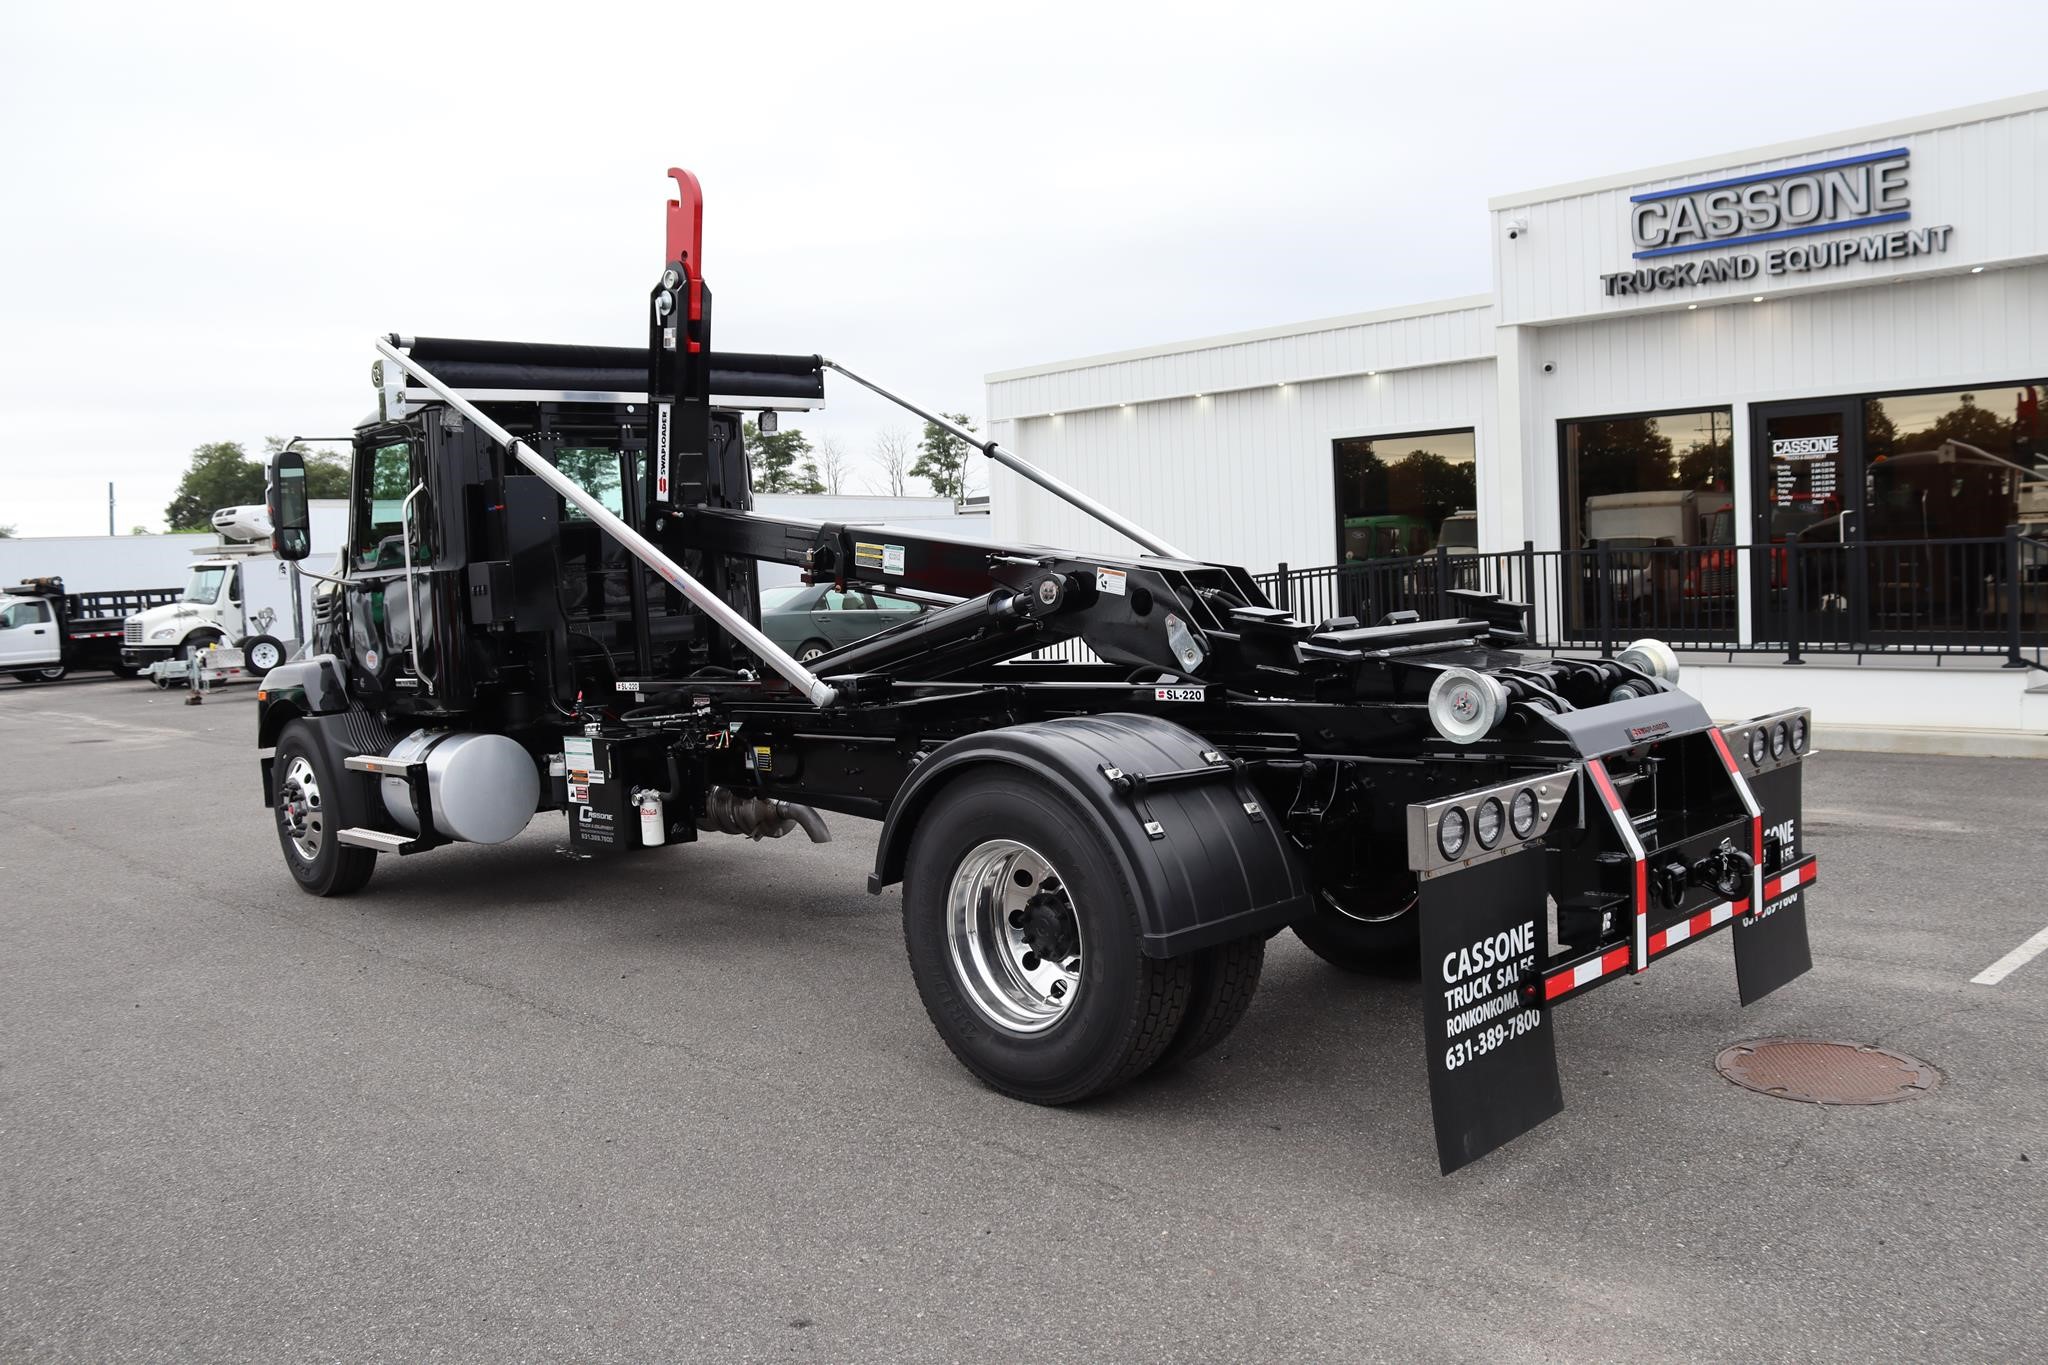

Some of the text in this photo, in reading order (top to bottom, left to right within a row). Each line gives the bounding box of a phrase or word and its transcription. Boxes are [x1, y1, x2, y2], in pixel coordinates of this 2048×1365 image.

[1631, 159, 1910, 247] CASSONE
[1765, 224, 1953, 275] EQUIPMENT
[1773, 438, 1838, 454] CASSONE
[1443, 921, 1535, 984] CASSONE
[1444, 973, 1492, 1012] TRUCK
[1446, 990, 1519, 1038] RONKONKOMA
[1445, 1010, 1541, 1070] 631-389-7800
